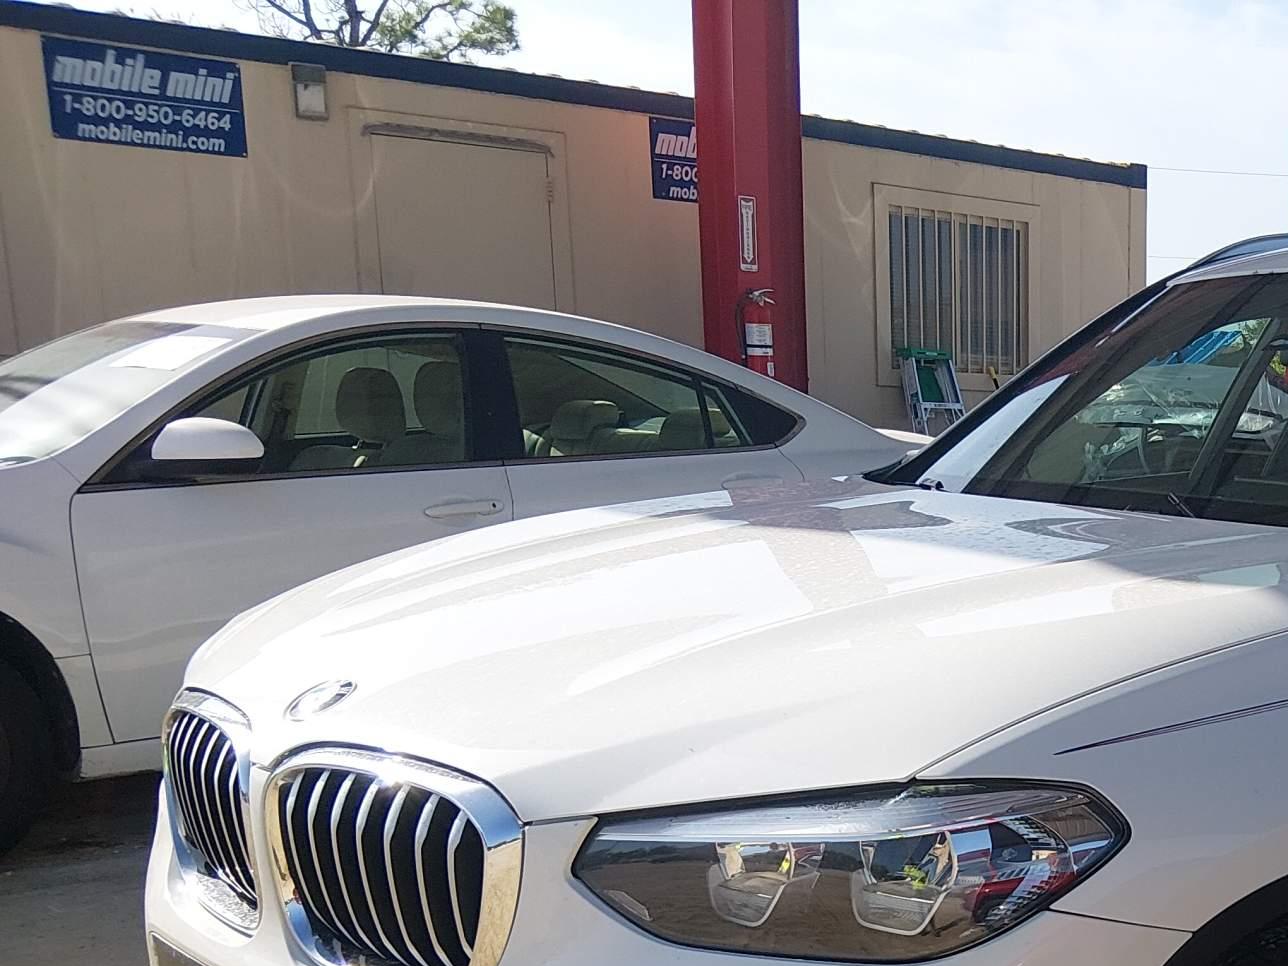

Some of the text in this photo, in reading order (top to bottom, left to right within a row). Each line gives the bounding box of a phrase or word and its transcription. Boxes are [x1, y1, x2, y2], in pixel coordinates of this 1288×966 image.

[53, 49, 234, 104] mobile mini
[63, 94, 232, 132] 1-800-950-6464
[77, 122, 226, 153] mobilemini.com
